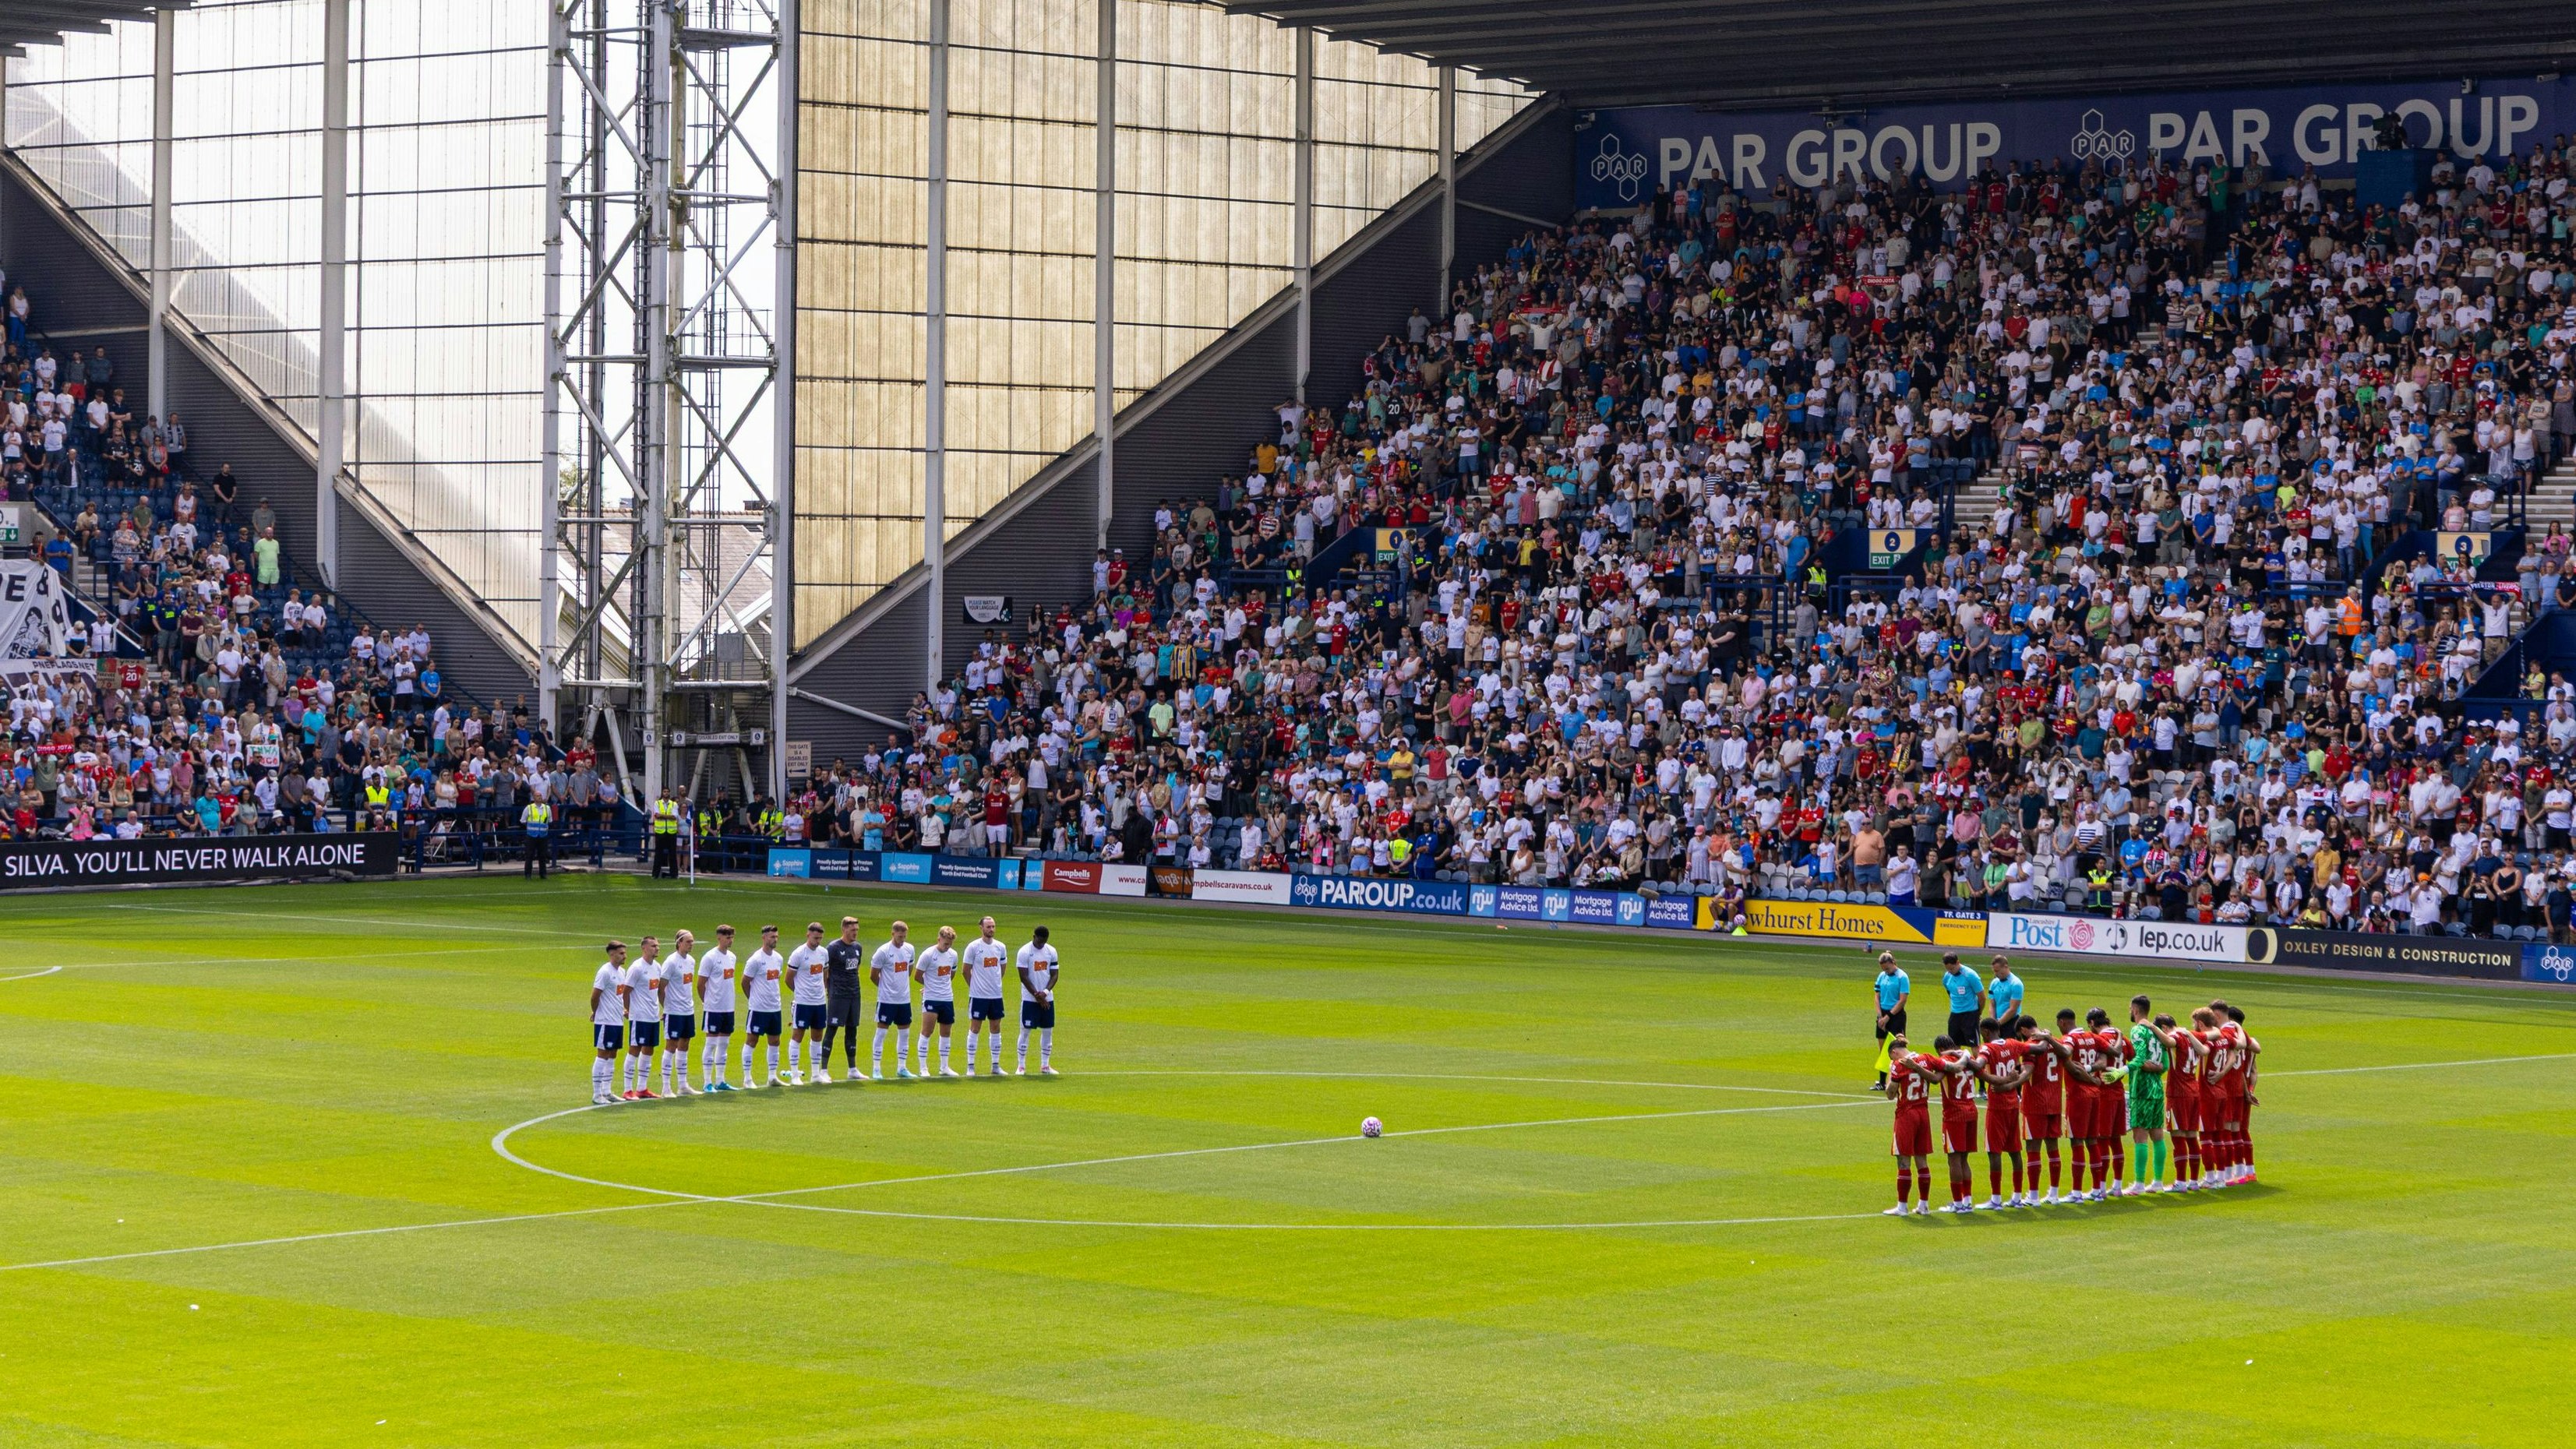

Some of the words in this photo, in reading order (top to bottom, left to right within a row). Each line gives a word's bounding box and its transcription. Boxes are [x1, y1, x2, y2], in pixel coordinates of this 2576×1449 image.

[2150, 108, 2271, 173] PAR
[2293, 95, 2539, 165] GROUP
[2078, 136, 2129, 153] PAR
[1660, 134, 1767, 192] PAR
[1786, 122, 2001, 188] GROUP
[1597, 159, 1643, 176] PAR
[1388, 404, 1400, 415] 20
[1890, 538, 1896, 547] 2
[2460, 541, 2467, 551] 3
[1378, 552, 1394, 561] EXIT
[1872, 555, 1890, 565] EXIT
[125, 672, 137, 682] 20
[5, 854, 69, 876] SILVA.
[74, 851, 150, 873] YOU'LL
[155, 848, 227, 871] NEVER
[232, 846, 291, 869] WALK
[295, 844, 365, 866] ALONE
[1054, 868, 1090, 879] Campbells
[1501, 890, 1537, 904] Mortgage
[1574, 895, 1612, 908] Mortgage
[1500, 901, 1526, 911] Advice
[1527, 903, 1539, 913] Ltd.
[1573, 905, 1600, 916] Advice
[1601, 907, 1613, 917] Ltd.
[1650, 899, 1689, 912] Mortgage
[1649, 910, 1675, 920] Advice
[1676, 911, 1689, 922] Ltd.
[1745, 905, 1813, 930] whurst
[1818, 908, 1884, 934] Homes
[2010, 917, 2063, 947] Post
[2140, 925, 2225, 953] lep.co.uk
[2285, 941, 2328, 954] OXLEY
[2333, 943, 2383, 958] DESIGN
[2387, 947, 2396, 959] &
[2401, 948, 2511, 967] CONSTRUCTION
[2544, 959, 2571, 969] PAR
[2046, 1052, 2059, 1082] 2
